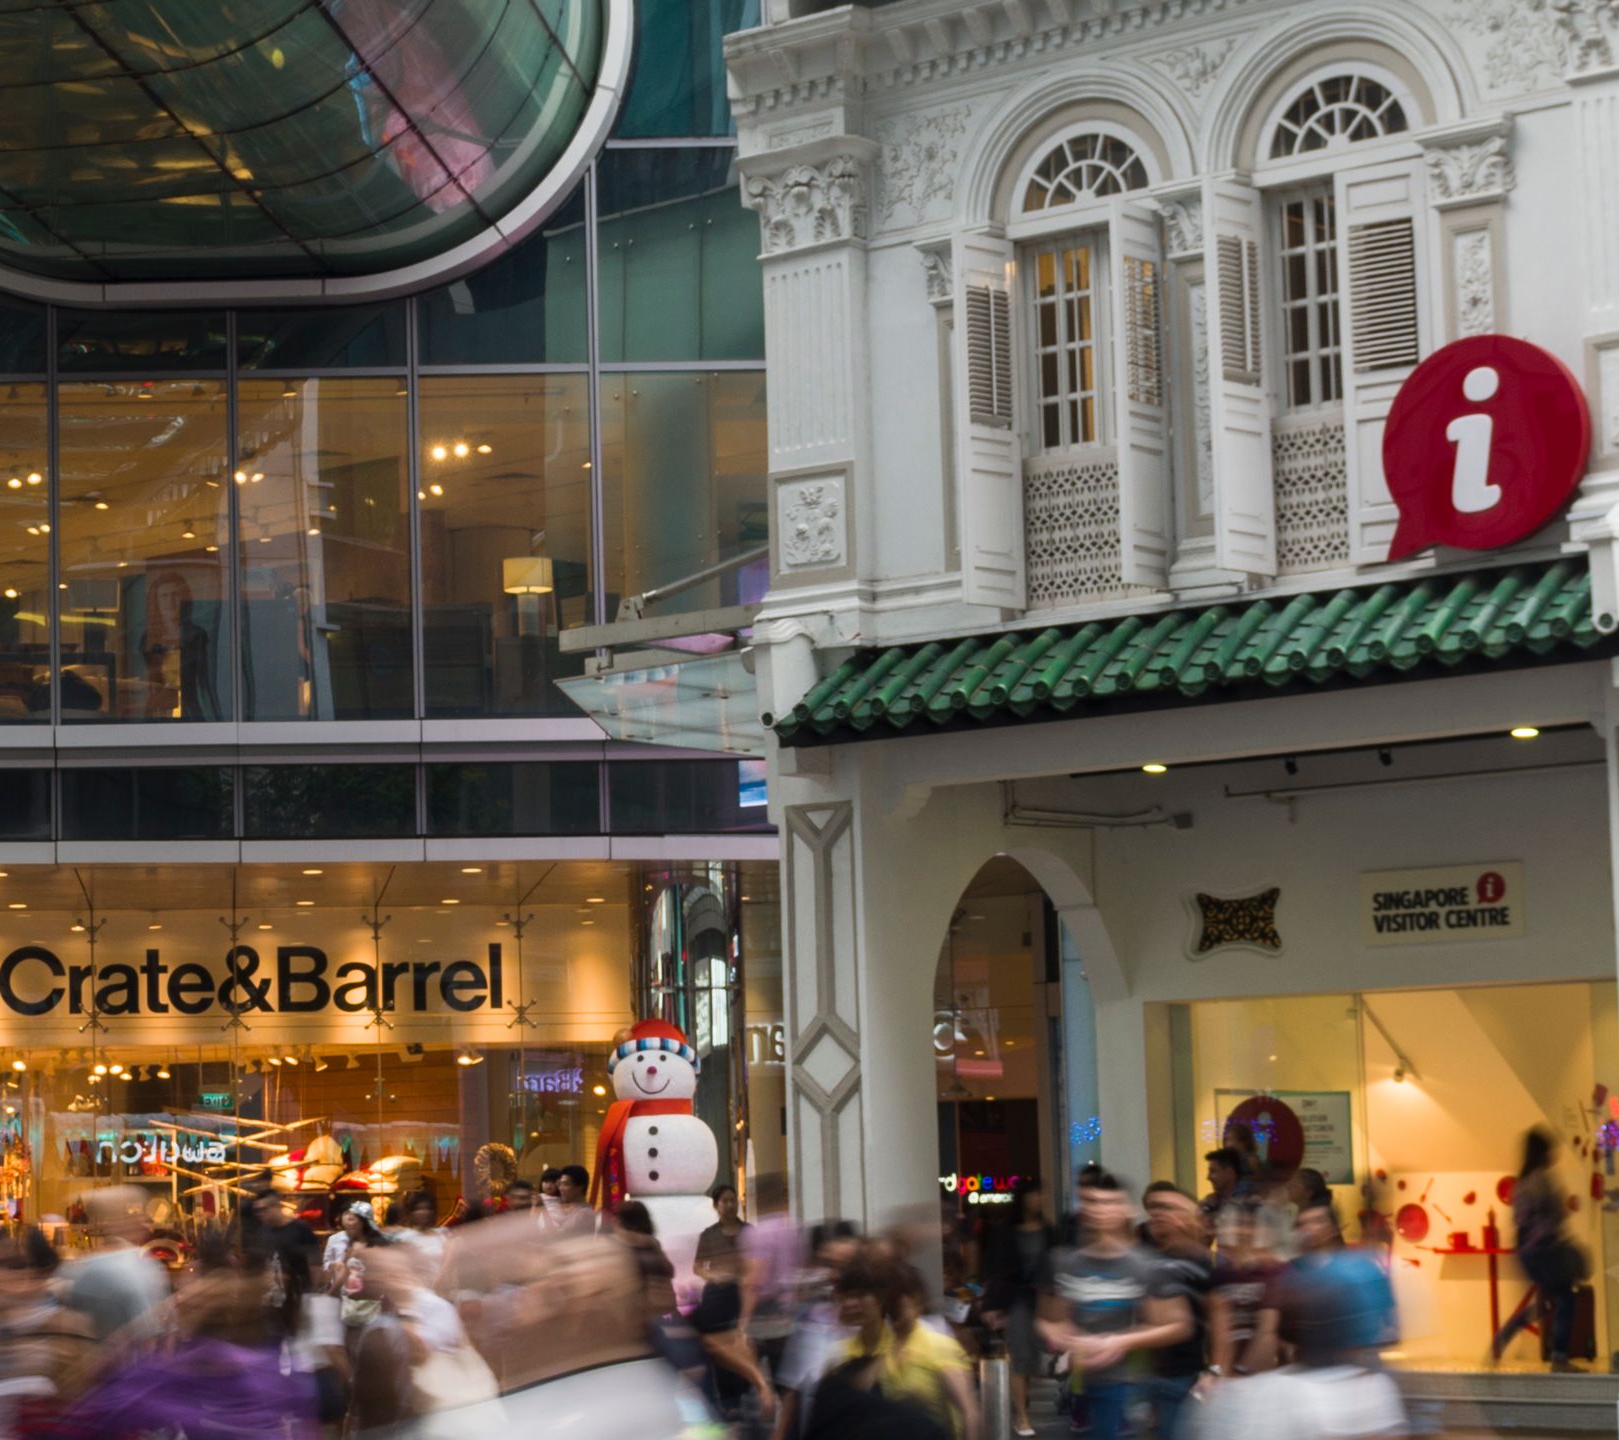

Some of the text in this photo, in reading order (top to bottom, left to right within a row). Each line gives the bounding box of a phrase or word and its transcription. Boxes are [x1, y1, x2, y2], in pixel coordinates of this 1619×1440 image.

[1372, 886, 1469, 912] SINGAPORE
[1373, 907, 1511, 933] VISITOR CENTRE
